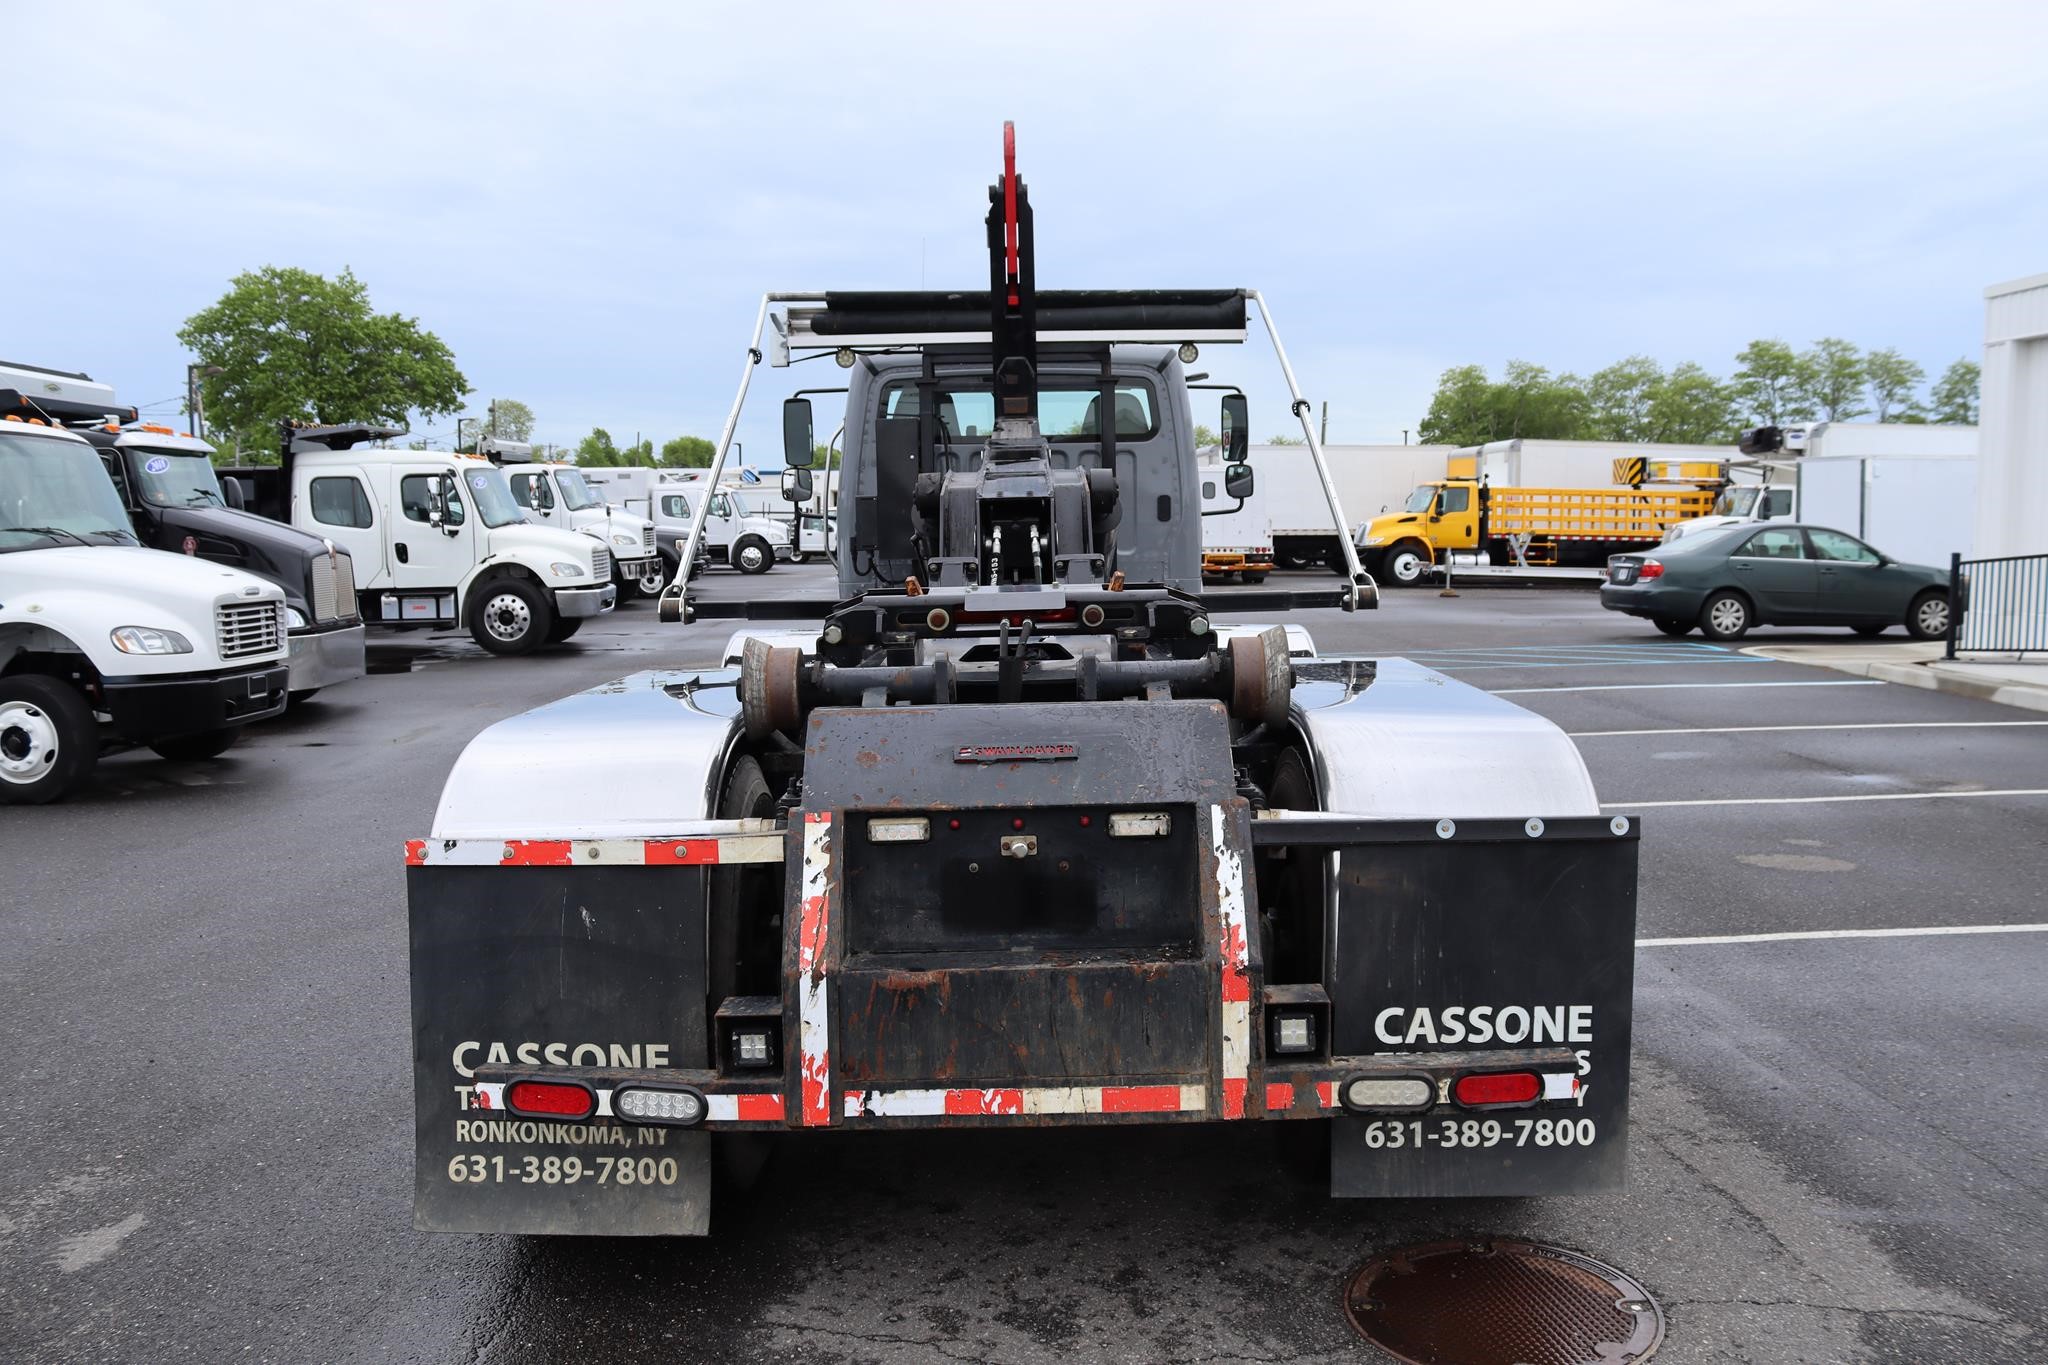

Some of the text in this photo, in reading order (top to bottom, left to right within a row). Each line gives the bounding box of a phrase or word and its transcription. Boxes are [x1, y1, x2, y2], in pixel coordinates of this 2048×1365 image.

[975, 744, 1073, 757] SWAPLOADER
[1374, 1005, 1593, 1044] CASSONE
[456, 1120, 668, 1148] RONKONKOMA, NY
[1365, 1118, 1596, 1149] 631-389-7800
[448, 1154, 679, 1185] 631-389-7800
